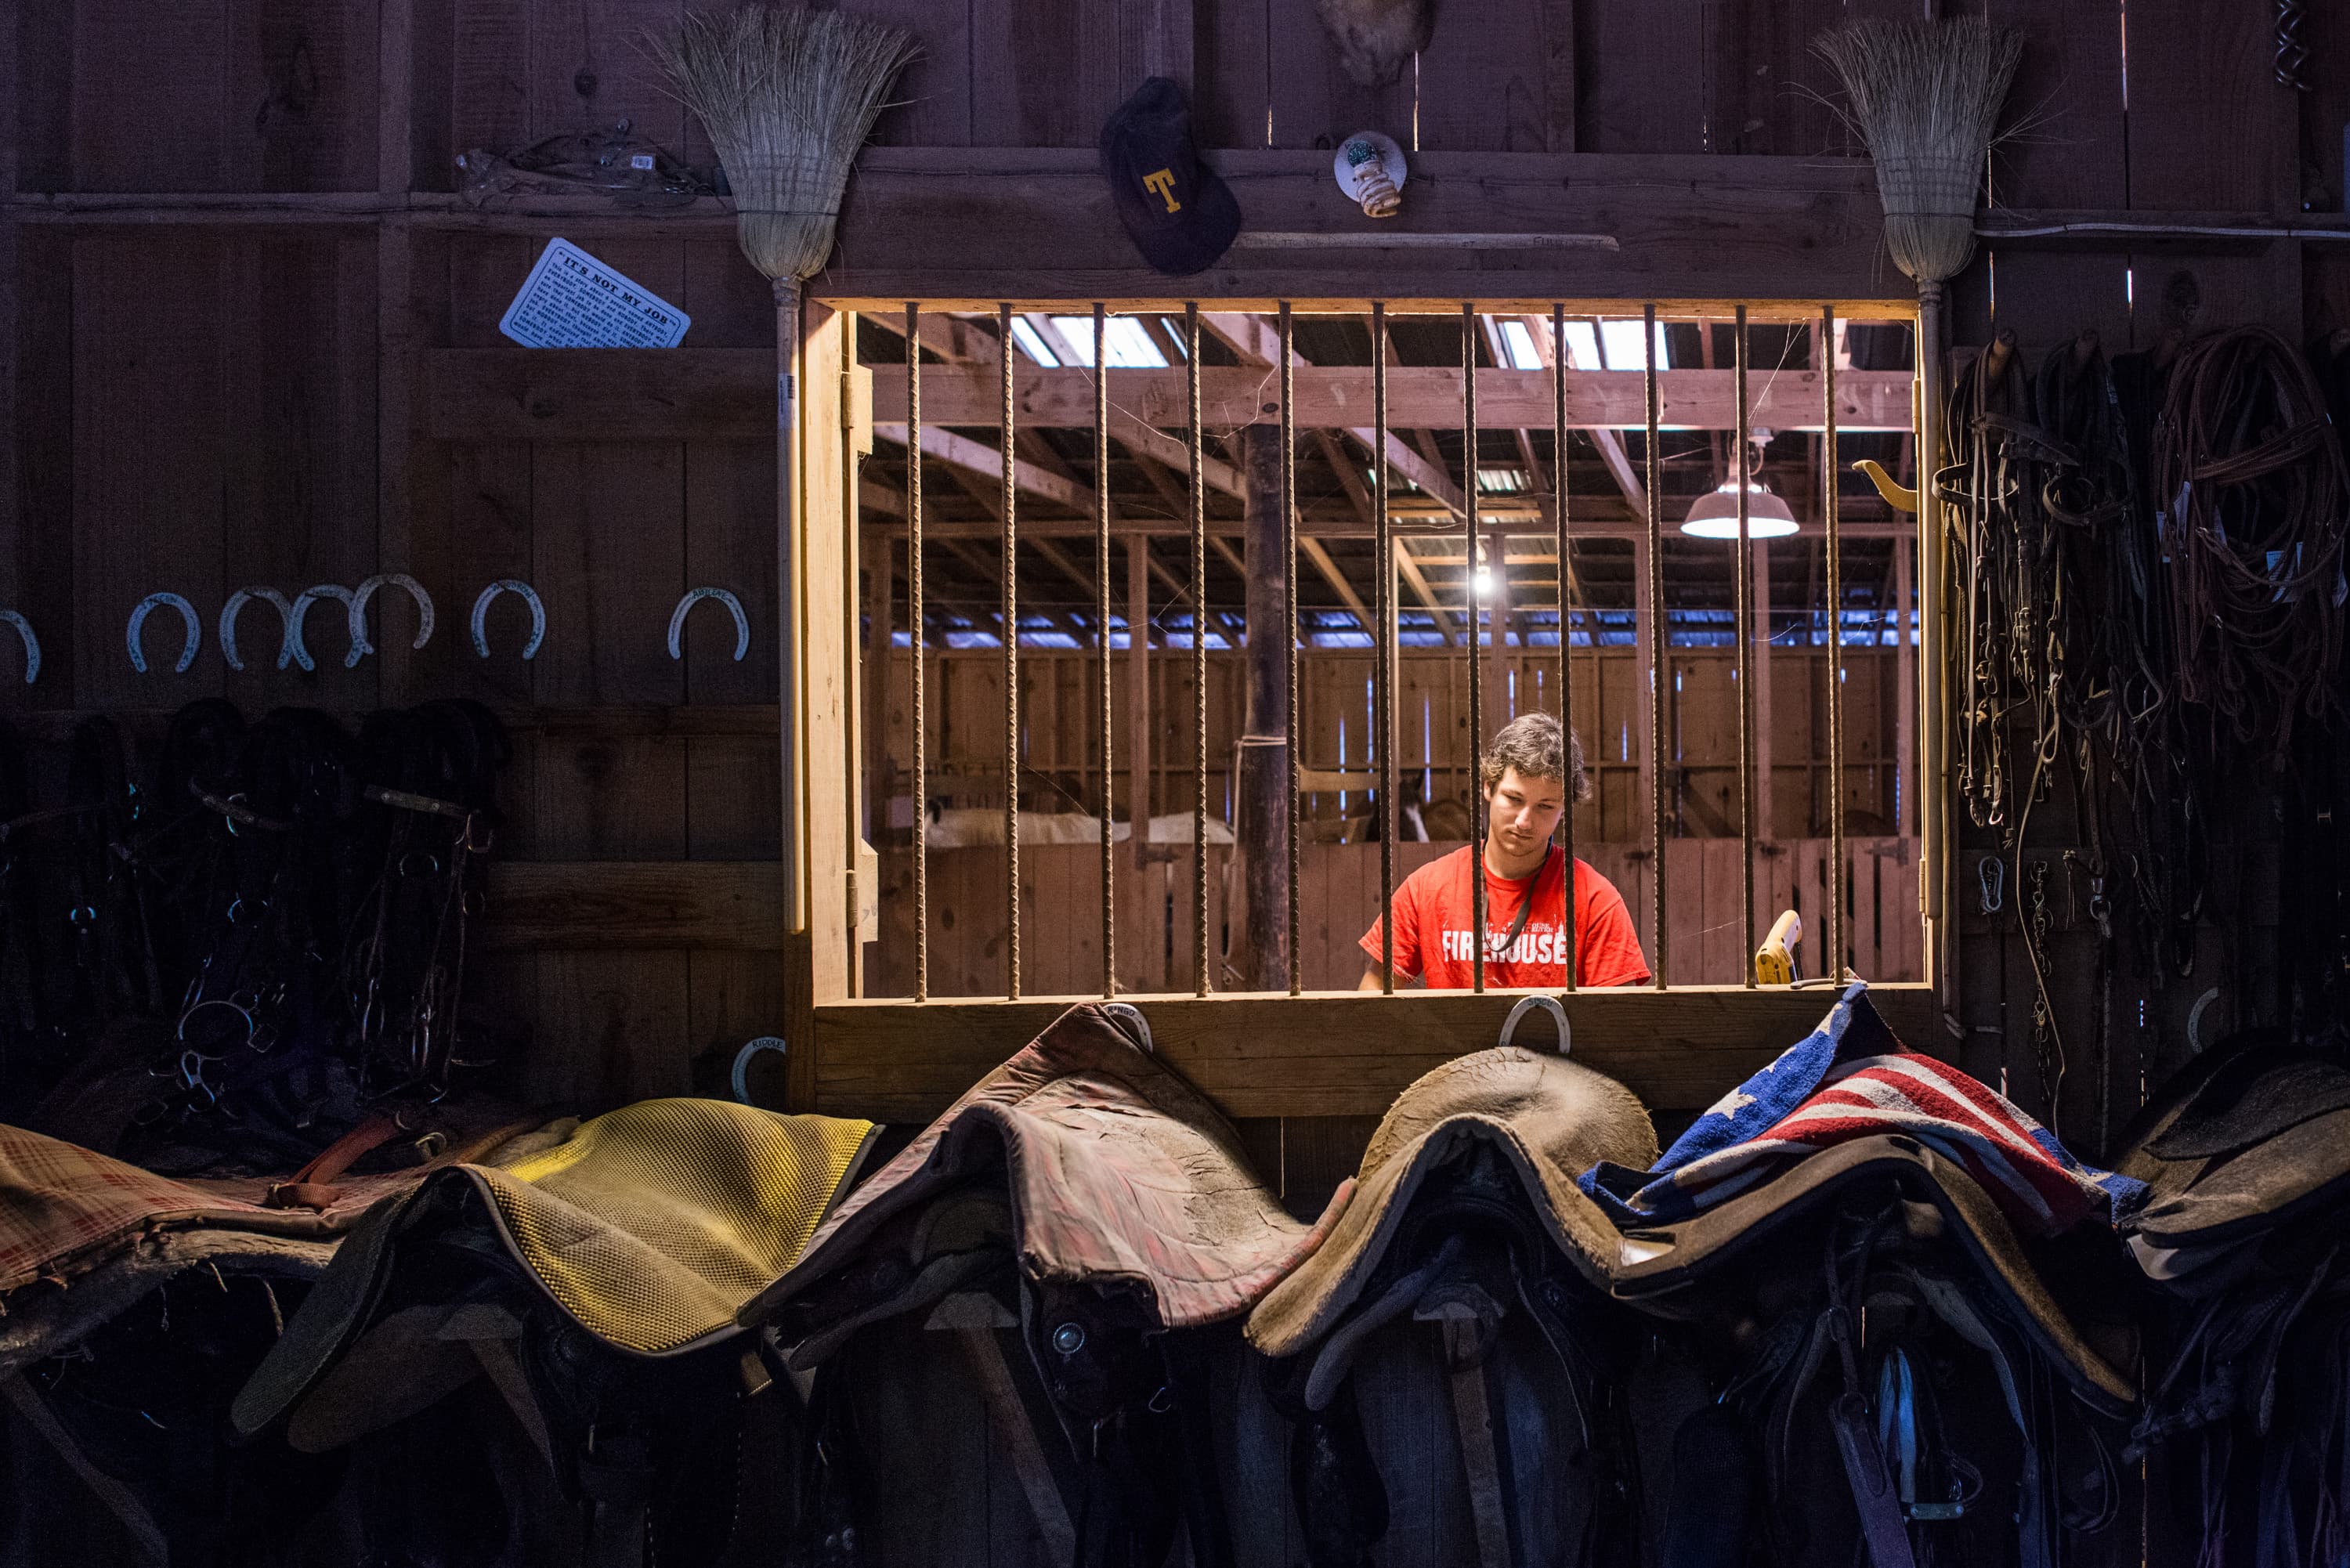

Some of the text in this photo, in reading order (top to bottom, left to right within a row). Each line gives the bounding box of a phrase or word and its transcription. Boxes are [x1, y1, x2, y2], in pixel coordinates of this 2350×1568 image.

[1142, 167, 1181, 214] T
[537, 286, 549, 295] have
[549, 294, 562, 304] done
[580, 313, 601, 327] NOBODY
[551, 279, 575, 296] important
[575, 294, 585, 302] job
[600, 309, 612, 318] done
[623, 323, 651, 342] EVERYBODY
[563, 256, 668, 324] IT'S NOT MY JOB
[574, 277, 588, 287] story
[589, 286, 603, 296] about
[609, 299, 626, 311] people
[627, 309, 644, 321] named
[578, 287, 606, 305] SOMEBODY
[639, 324, 654, 336] There
[518, 314, 547, 334] SOMEBODY
[533, 292, 548, 304] angry
[548, 302, 564, 313] about
[579, 320, 599, 334] because
[541, 305, 570, 325] EVERYBODY
[571, 323, 591, 338] thought
[552, 287, 563, 296] that
[564, 294, 591, 313] SOMEBODY
[591, 312, 606, 323] would
[621, 330, 644, 346] ANYBODY
[1442, 929, 1567, 965] FIREHOUSE
[1107, 1006, 1136, 1017] RINGO
